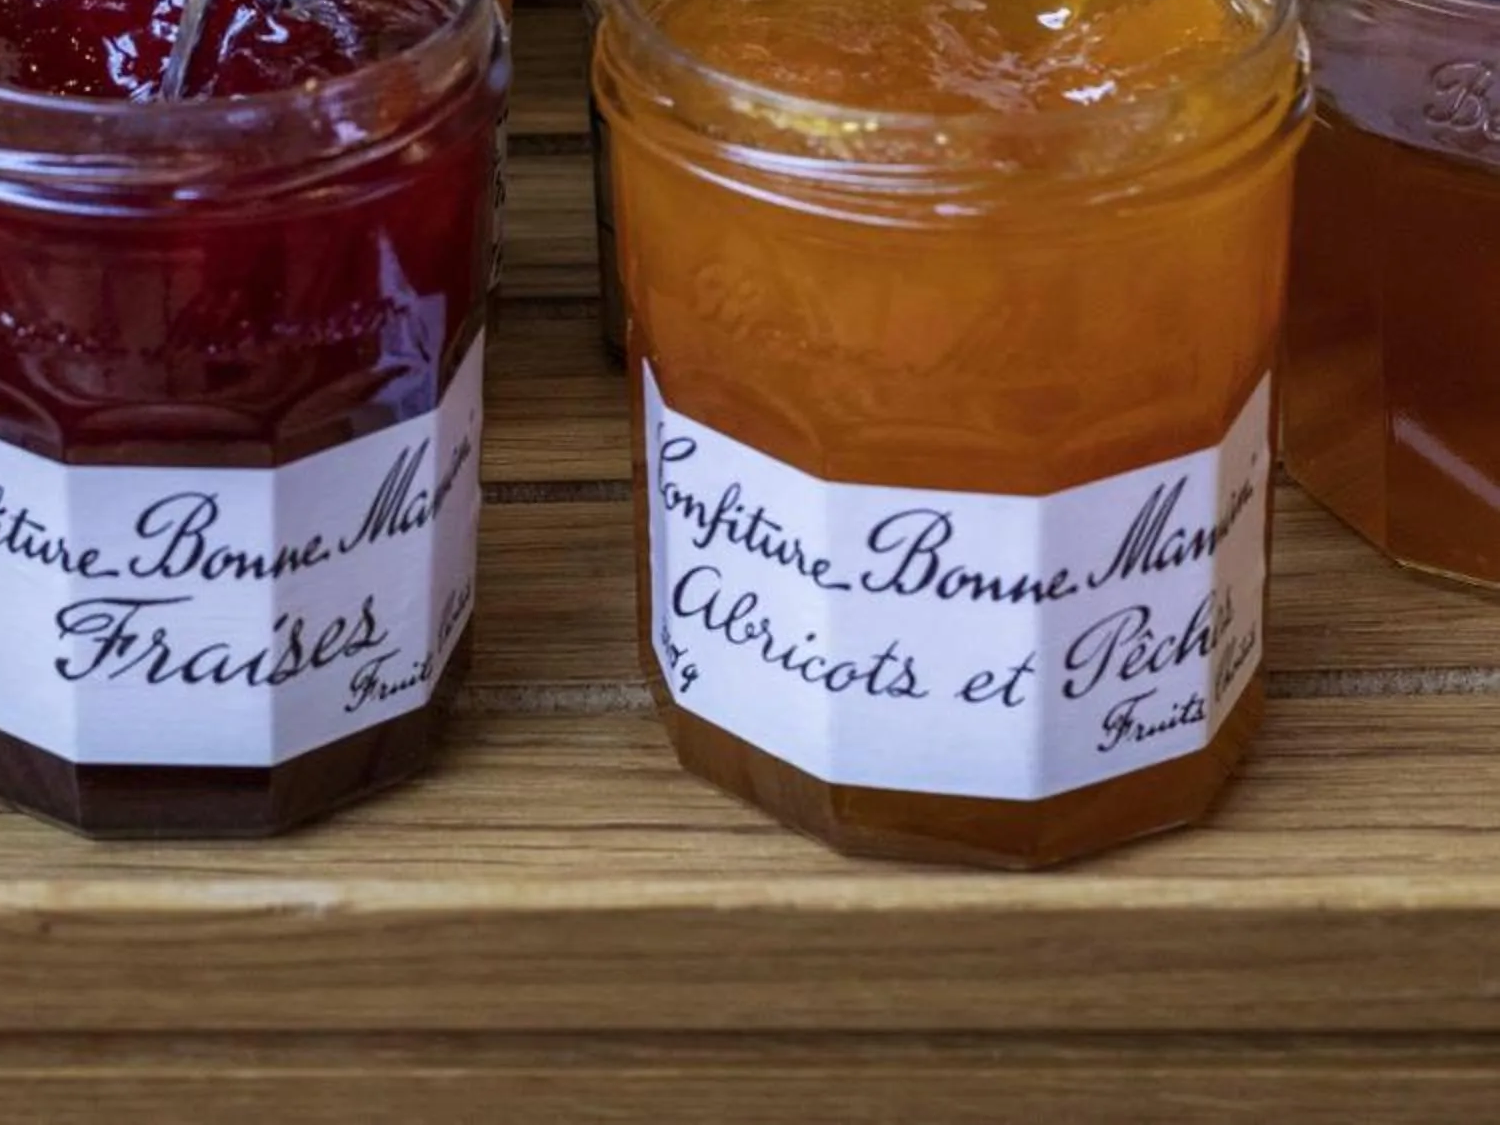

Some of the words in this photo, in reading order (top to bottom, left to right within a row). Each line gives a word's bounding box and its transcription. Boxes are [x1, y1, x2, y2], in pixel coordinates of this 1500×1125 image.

[129, 491, 331, 581] Bonne
[656, 421, 851, 591] Confiture
[860, 508, 1078, 603] Bonne
[54, 594, 390, 687] Fraises
[672, 564, 929, 699] Abricots
[954, 651, 1039, 707] et
[1096, 688, 1208, 753] Fruits
